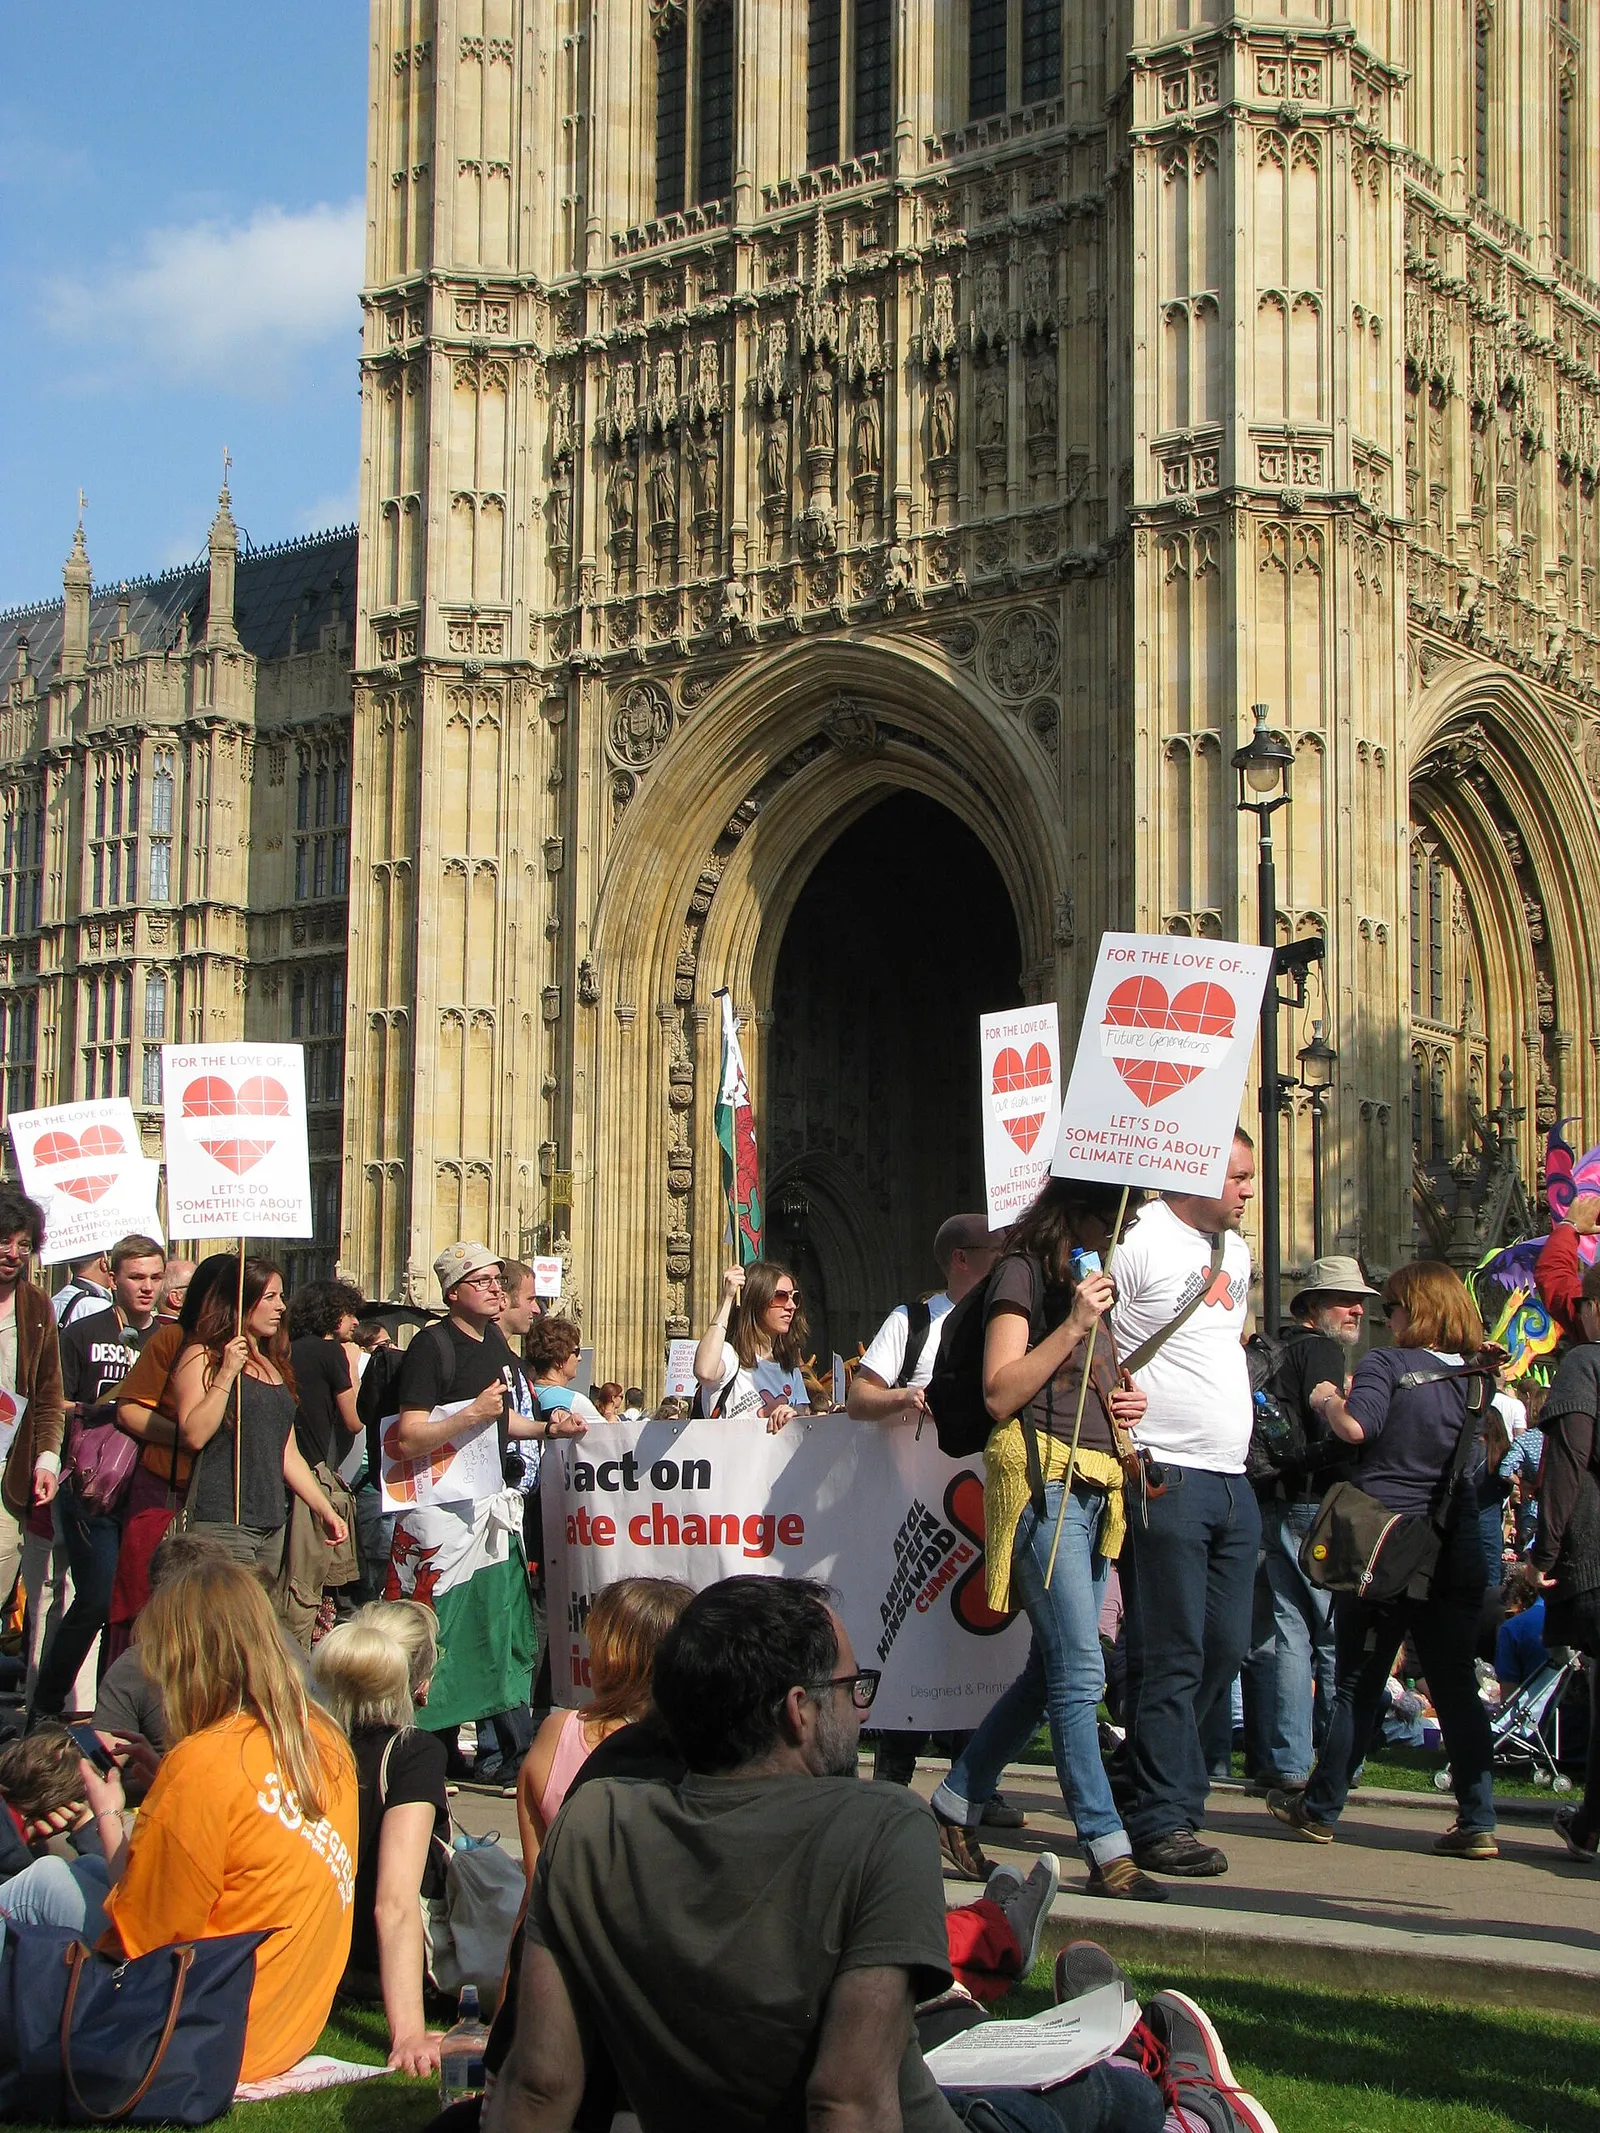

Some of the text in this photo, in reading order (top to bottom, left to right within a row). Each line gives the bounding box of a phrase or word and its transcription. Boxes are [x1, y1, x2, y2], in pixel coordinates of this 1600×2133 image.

[1106, 949, 1256, 976] FOR THE LOVE OF...
[985, 1027, 1001, 1040] FOR
[1003, 1024, 1018, 1037] THE
[1020, 1021, 1038, 1034] LOVE
[1105, 1029, 1145, 1048] Future
[172, 1058, 197, 1068] FOR
[201, 1056, 226, 1066] THE
[230, 1056, 263, 1066] LOVE
[18, 1120, 41, 1131] FOR
[44, 1115, 66, 1126] THE
[69, 1110, 97, 1122] LOVE
[1110, 1114, 1179, 1135] LET'S DO
[1065, 1128, 1221, 1159] SOMETHING ABOUT
[1009, 1162, 1043, 1178] LET'S DO
[1069, 1146, 1209, 1176] CLIMATE CHANGE
[211, 1184, 269, 1195] LET'S DO
[990, 1179, 1036, 1198] SOMETHING
[176, 1198, 302, 1211] SOMETHING ABOUT
[994, 1196, 1028, 1212] CLIMATE
[70, 1208, 120, 1223] LET'S DO
[114, 1216, 151, 1226] ABOUT
[182, 1211, 298, 1224] CLIMATE CHANGE
[50, 1233, 99, 1250] CLIMATE
[574, 1450, 639, 1491] act
[650, 1458, 711, 1491] on
[566, 1502, 805, 1558] ate change
[910, 1681, 1010, 1700] Designed & Printe
